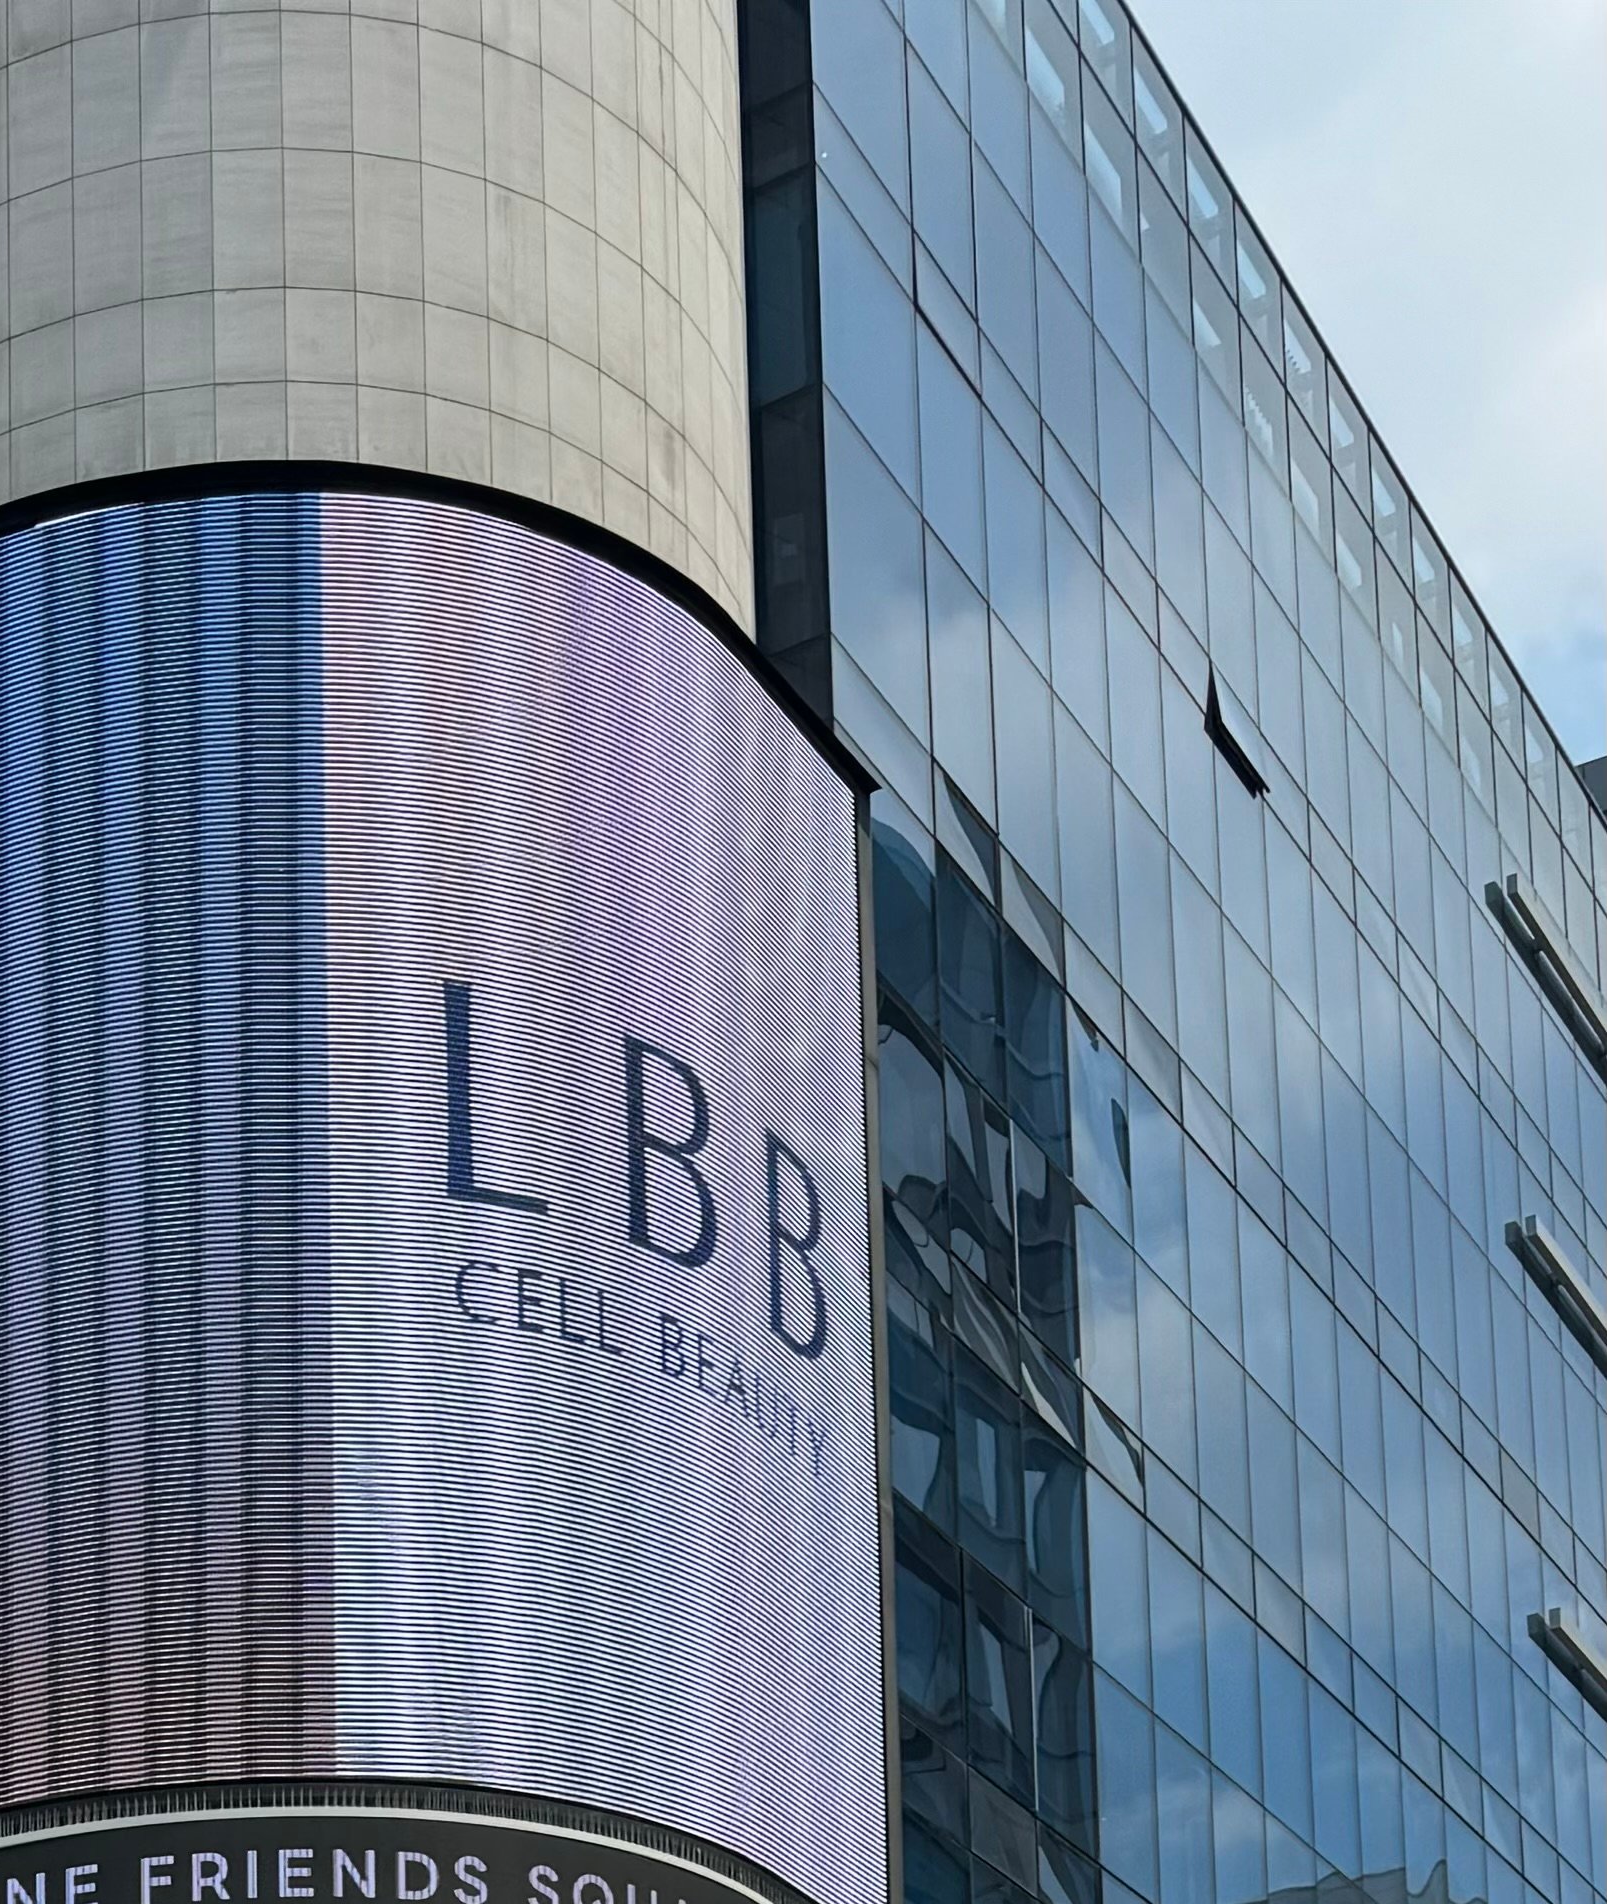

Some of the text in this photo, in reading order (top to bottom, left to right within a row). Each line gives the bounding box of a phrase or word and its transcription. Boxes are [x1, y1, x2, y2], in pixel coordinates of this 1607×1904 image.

[455, 1260, 827, 1478] CELL BEAUTY
[141, 1849, 487, 1904] FRIENDS
